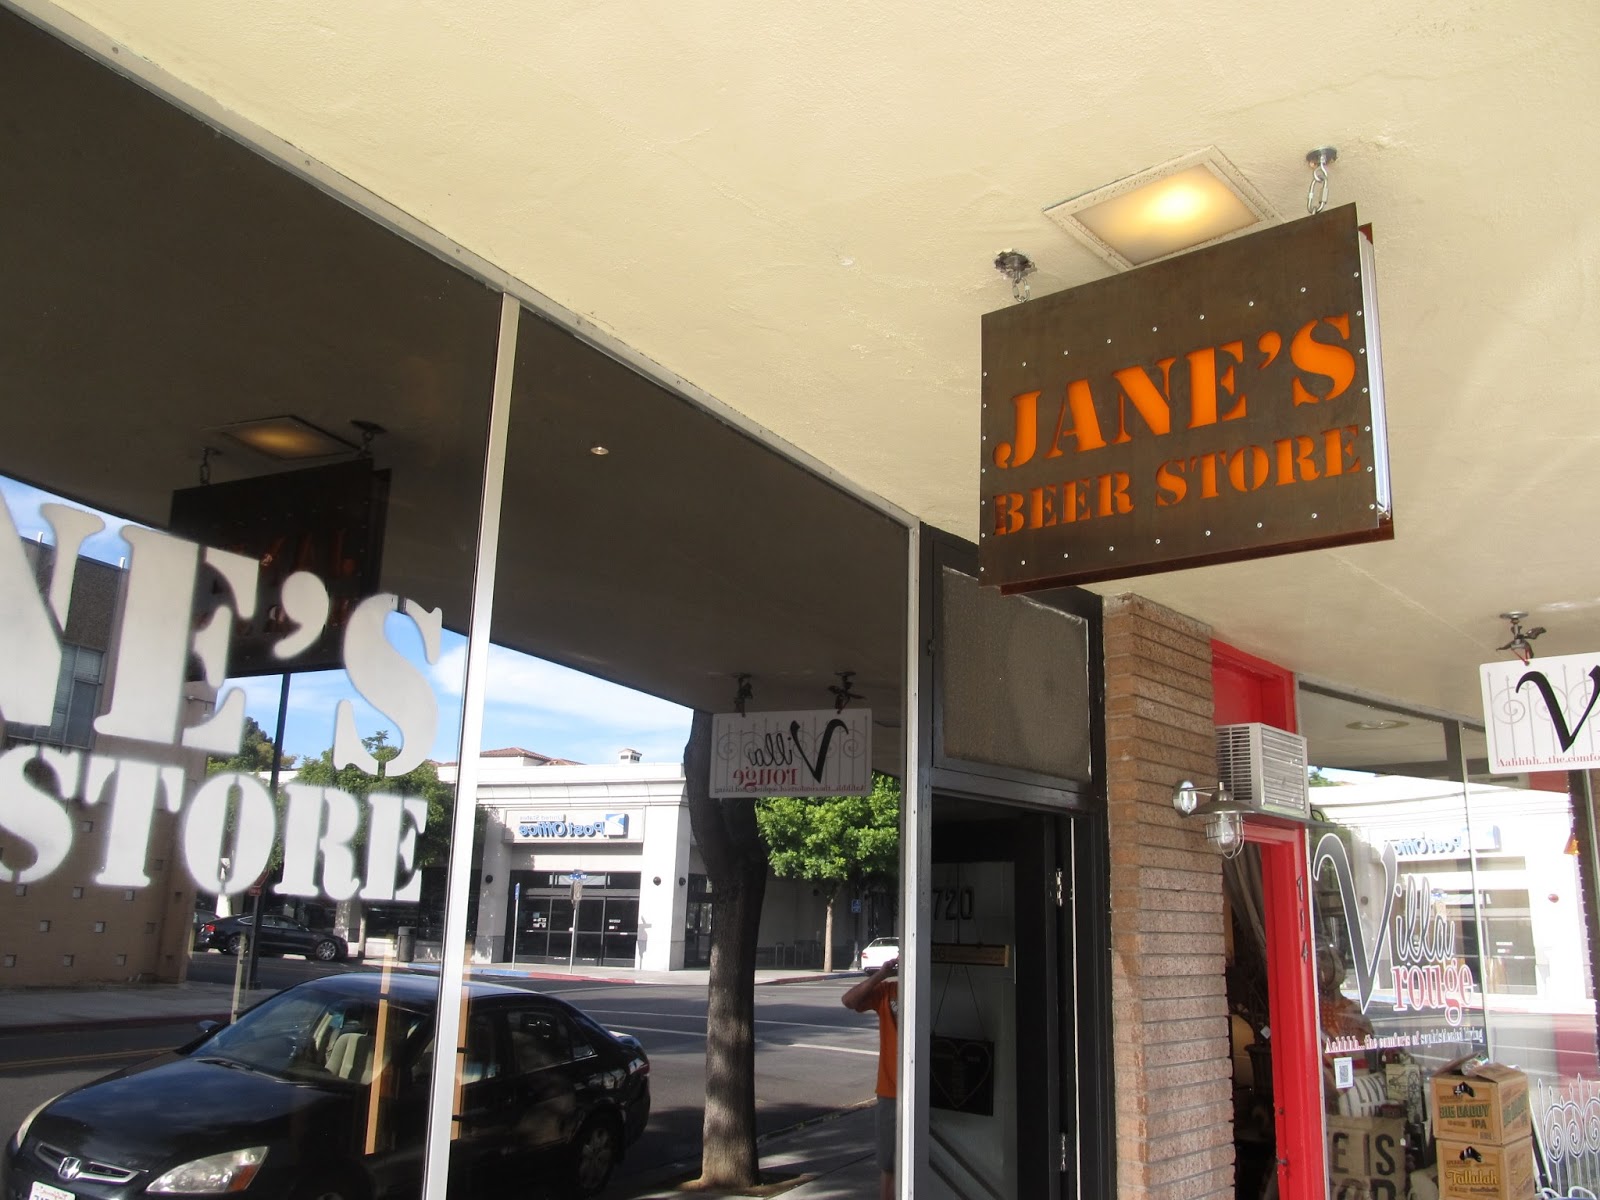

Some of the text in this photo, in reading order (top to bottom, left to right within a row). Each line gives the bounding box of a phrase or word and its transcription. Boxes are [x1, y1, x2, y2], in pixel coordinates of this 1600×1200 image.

[992, 313, 1357, 470] JANE'S
[992, 424, 1362, 537] BEER STORE
[0, 744, 428, 901] STORE
[932, 887, 973, 921] 720
[1313, 832, 1456, 1015] Villa
[1391, 960, 1475, 1026] rouge
[1471, 1119, 1487, 1129] IPA
[1445, 1169, 1499, 1186] Tallulah
